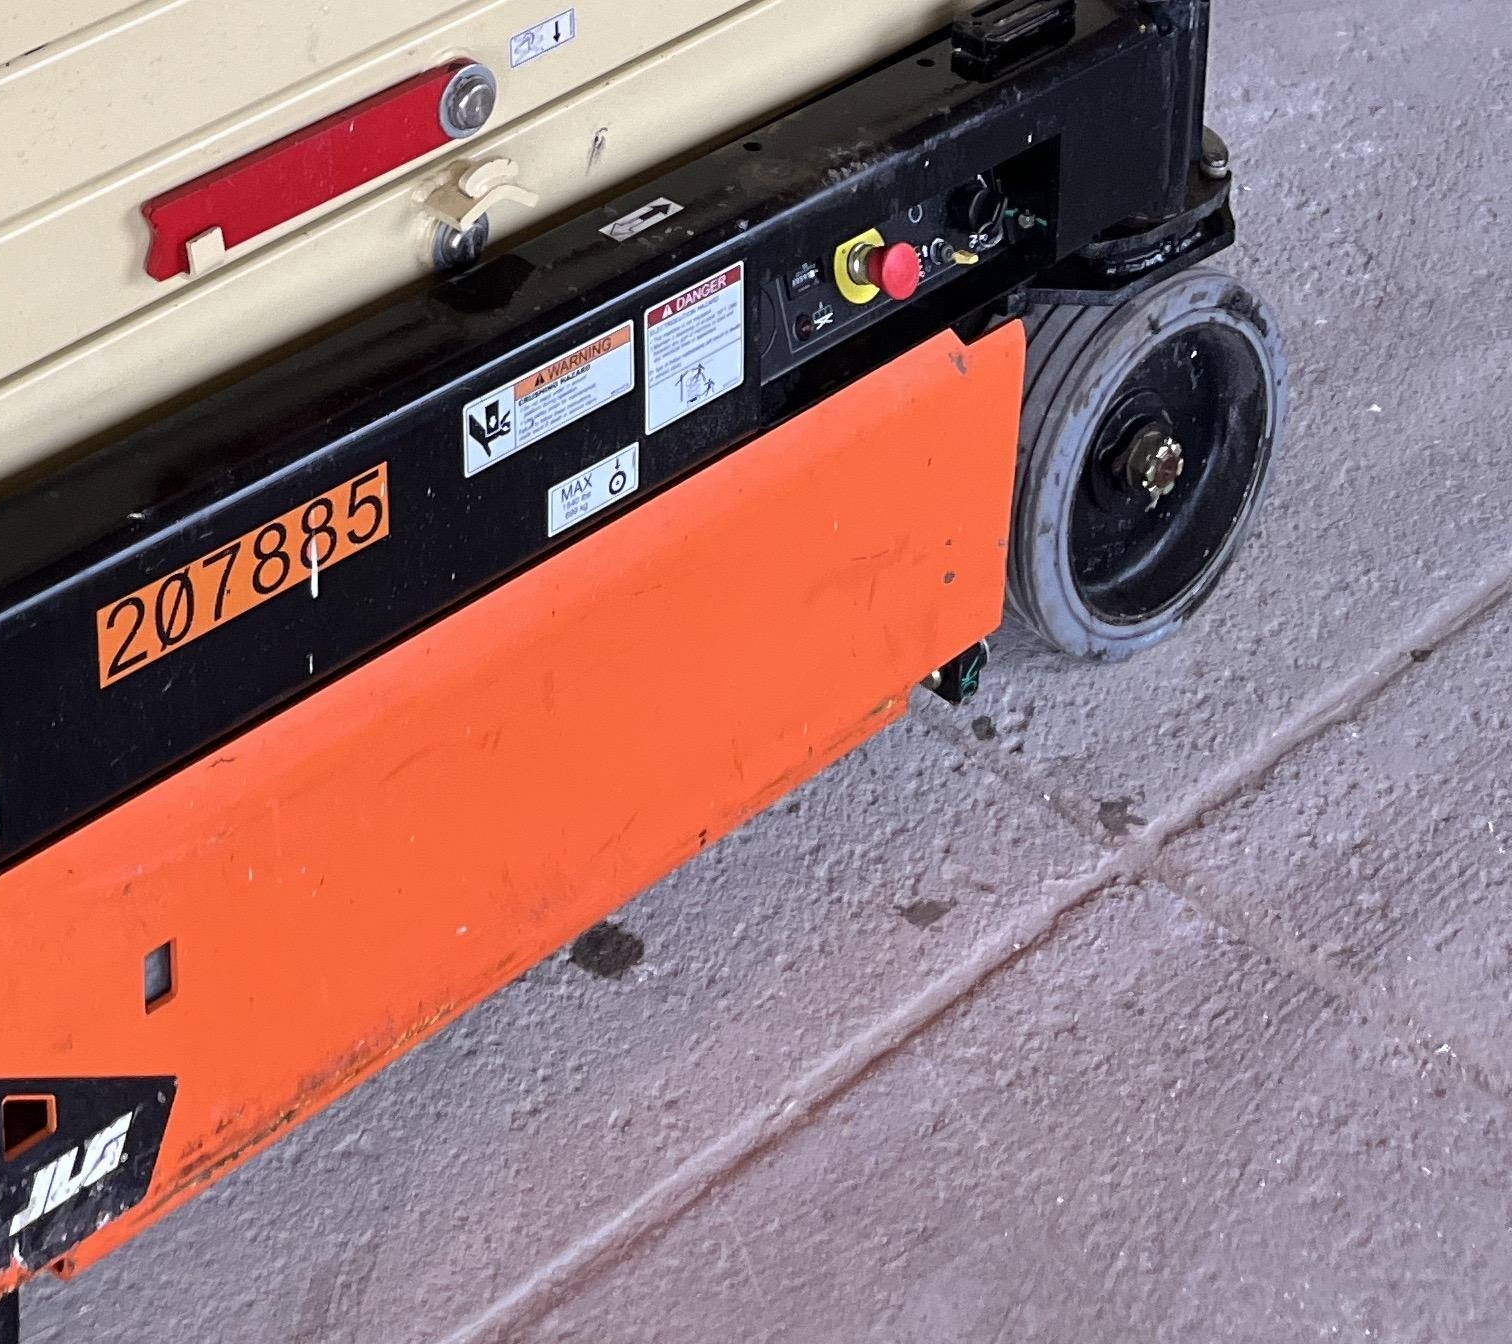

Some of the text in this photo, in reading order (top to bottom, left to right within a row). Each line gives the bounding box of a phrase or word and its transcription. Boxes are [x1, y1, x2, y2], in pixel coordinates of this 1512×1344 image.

[676, 274, 727, 312] DANGER
[547, 337, 612, 379] WARNING
[561, 473, 592, 501] MAX
[105, 468, 384, 680] 207885
[9, 1111, 133, 1237] JLG
